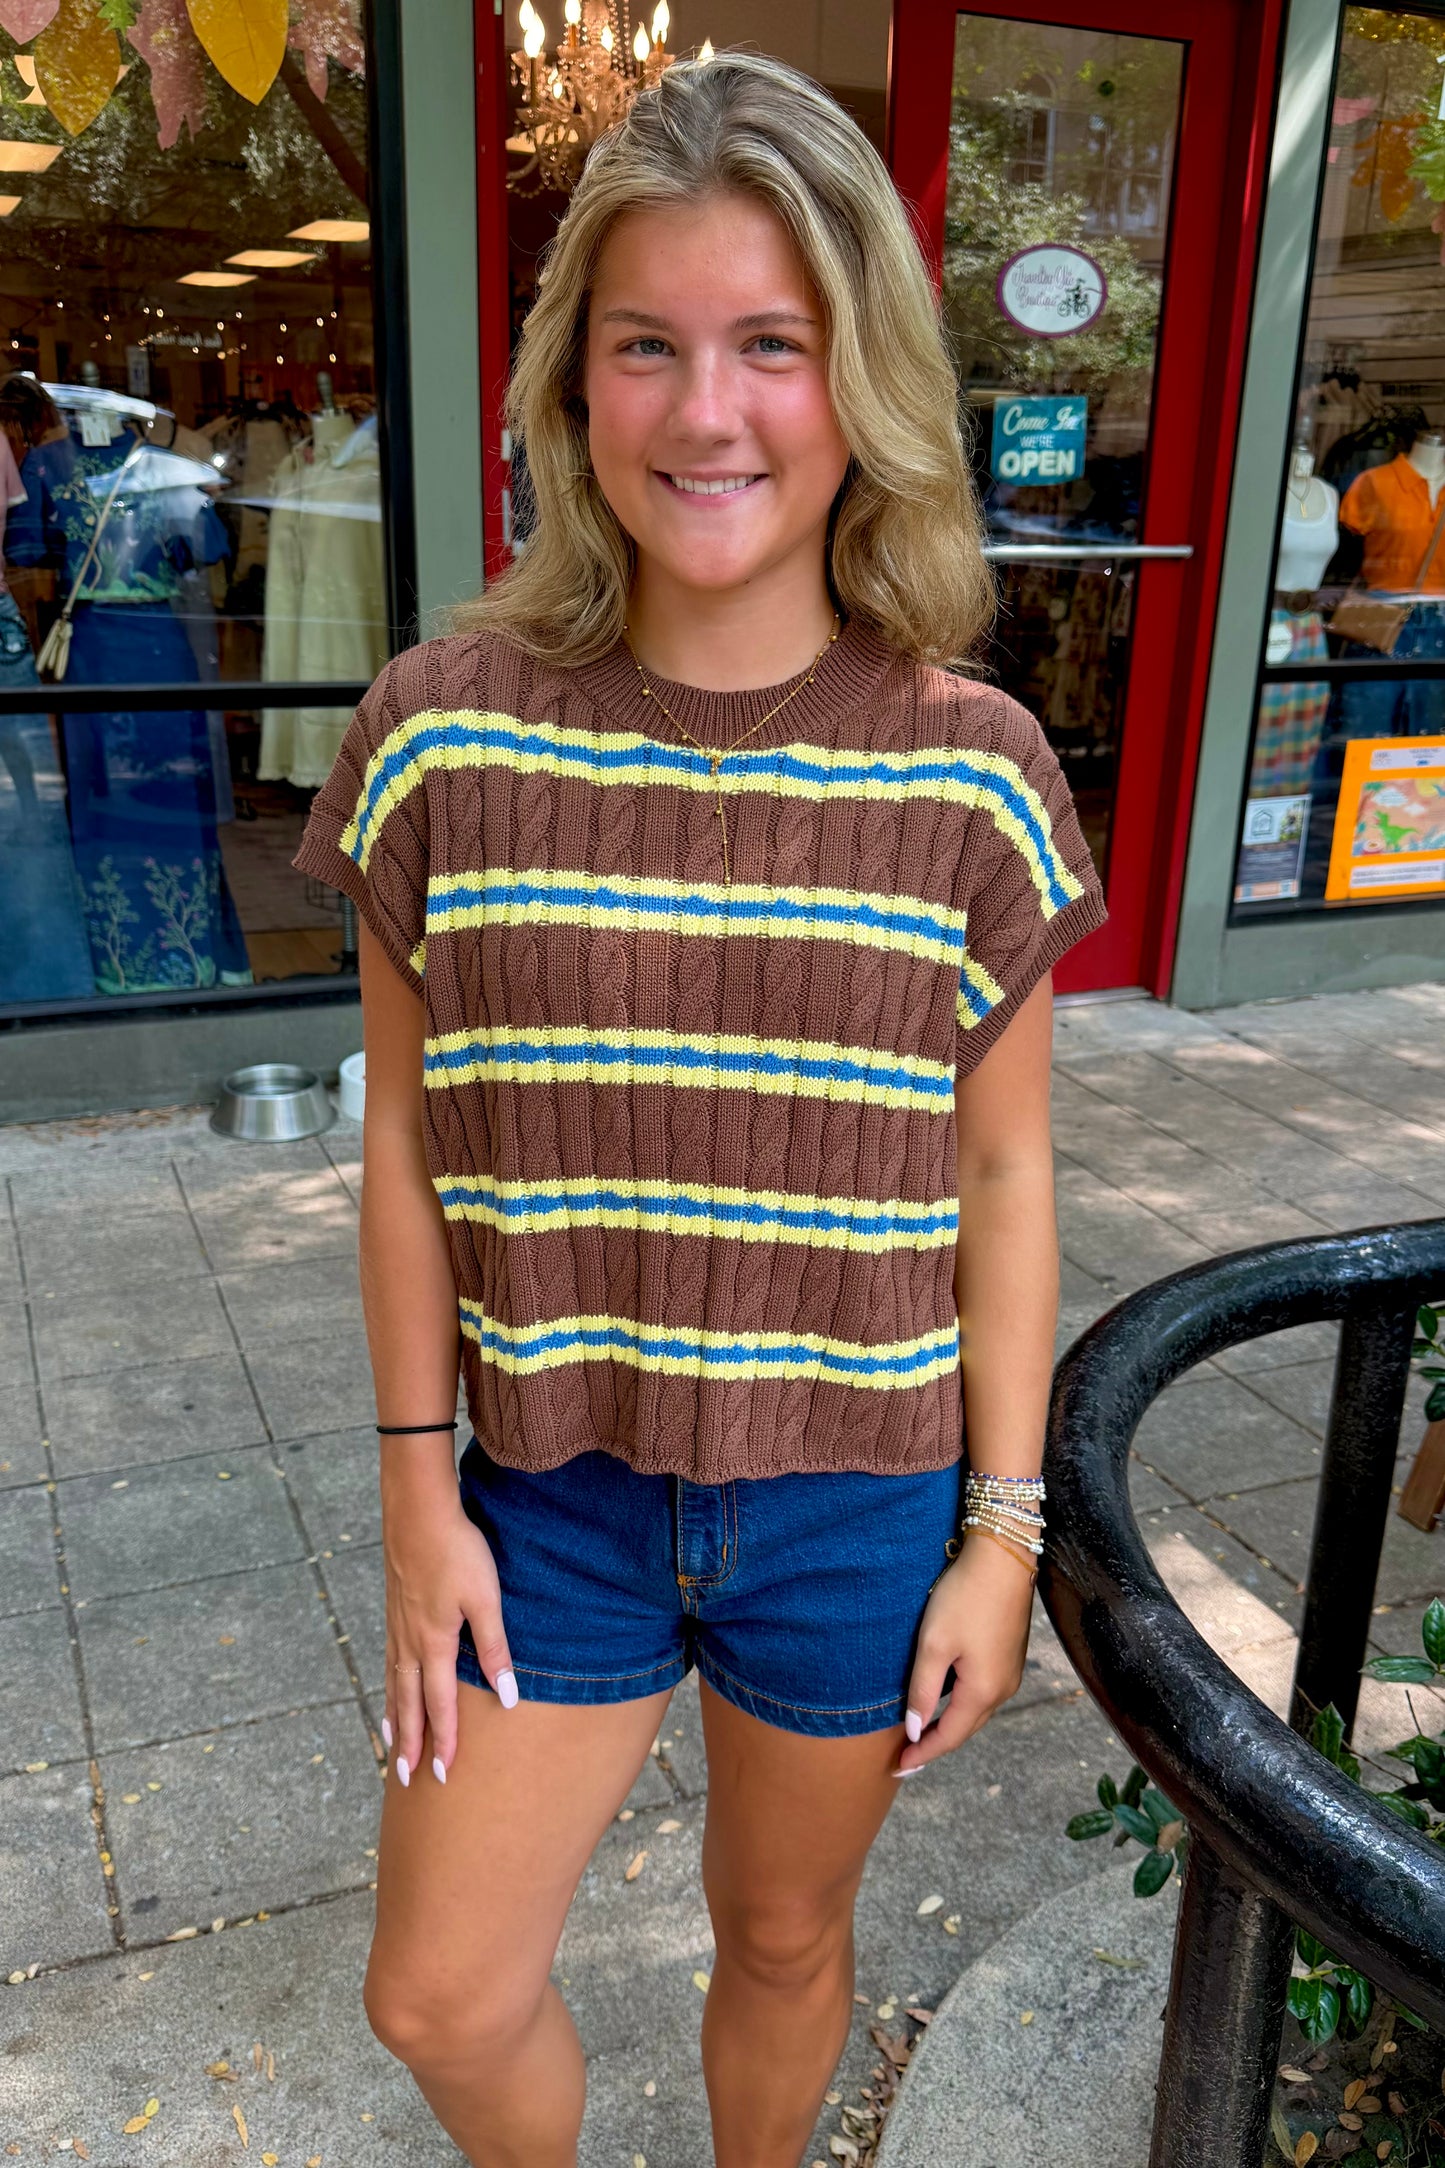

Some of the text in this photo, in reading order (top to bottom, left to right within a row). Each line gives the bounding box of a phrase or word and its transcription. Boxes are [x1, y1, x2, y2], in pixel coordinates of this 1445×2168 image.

[1003, 405, 1084, 436] Come In
[1020, 434, 1056, 449] WE'RE
[998, 449, 1076, 477] OPEN
